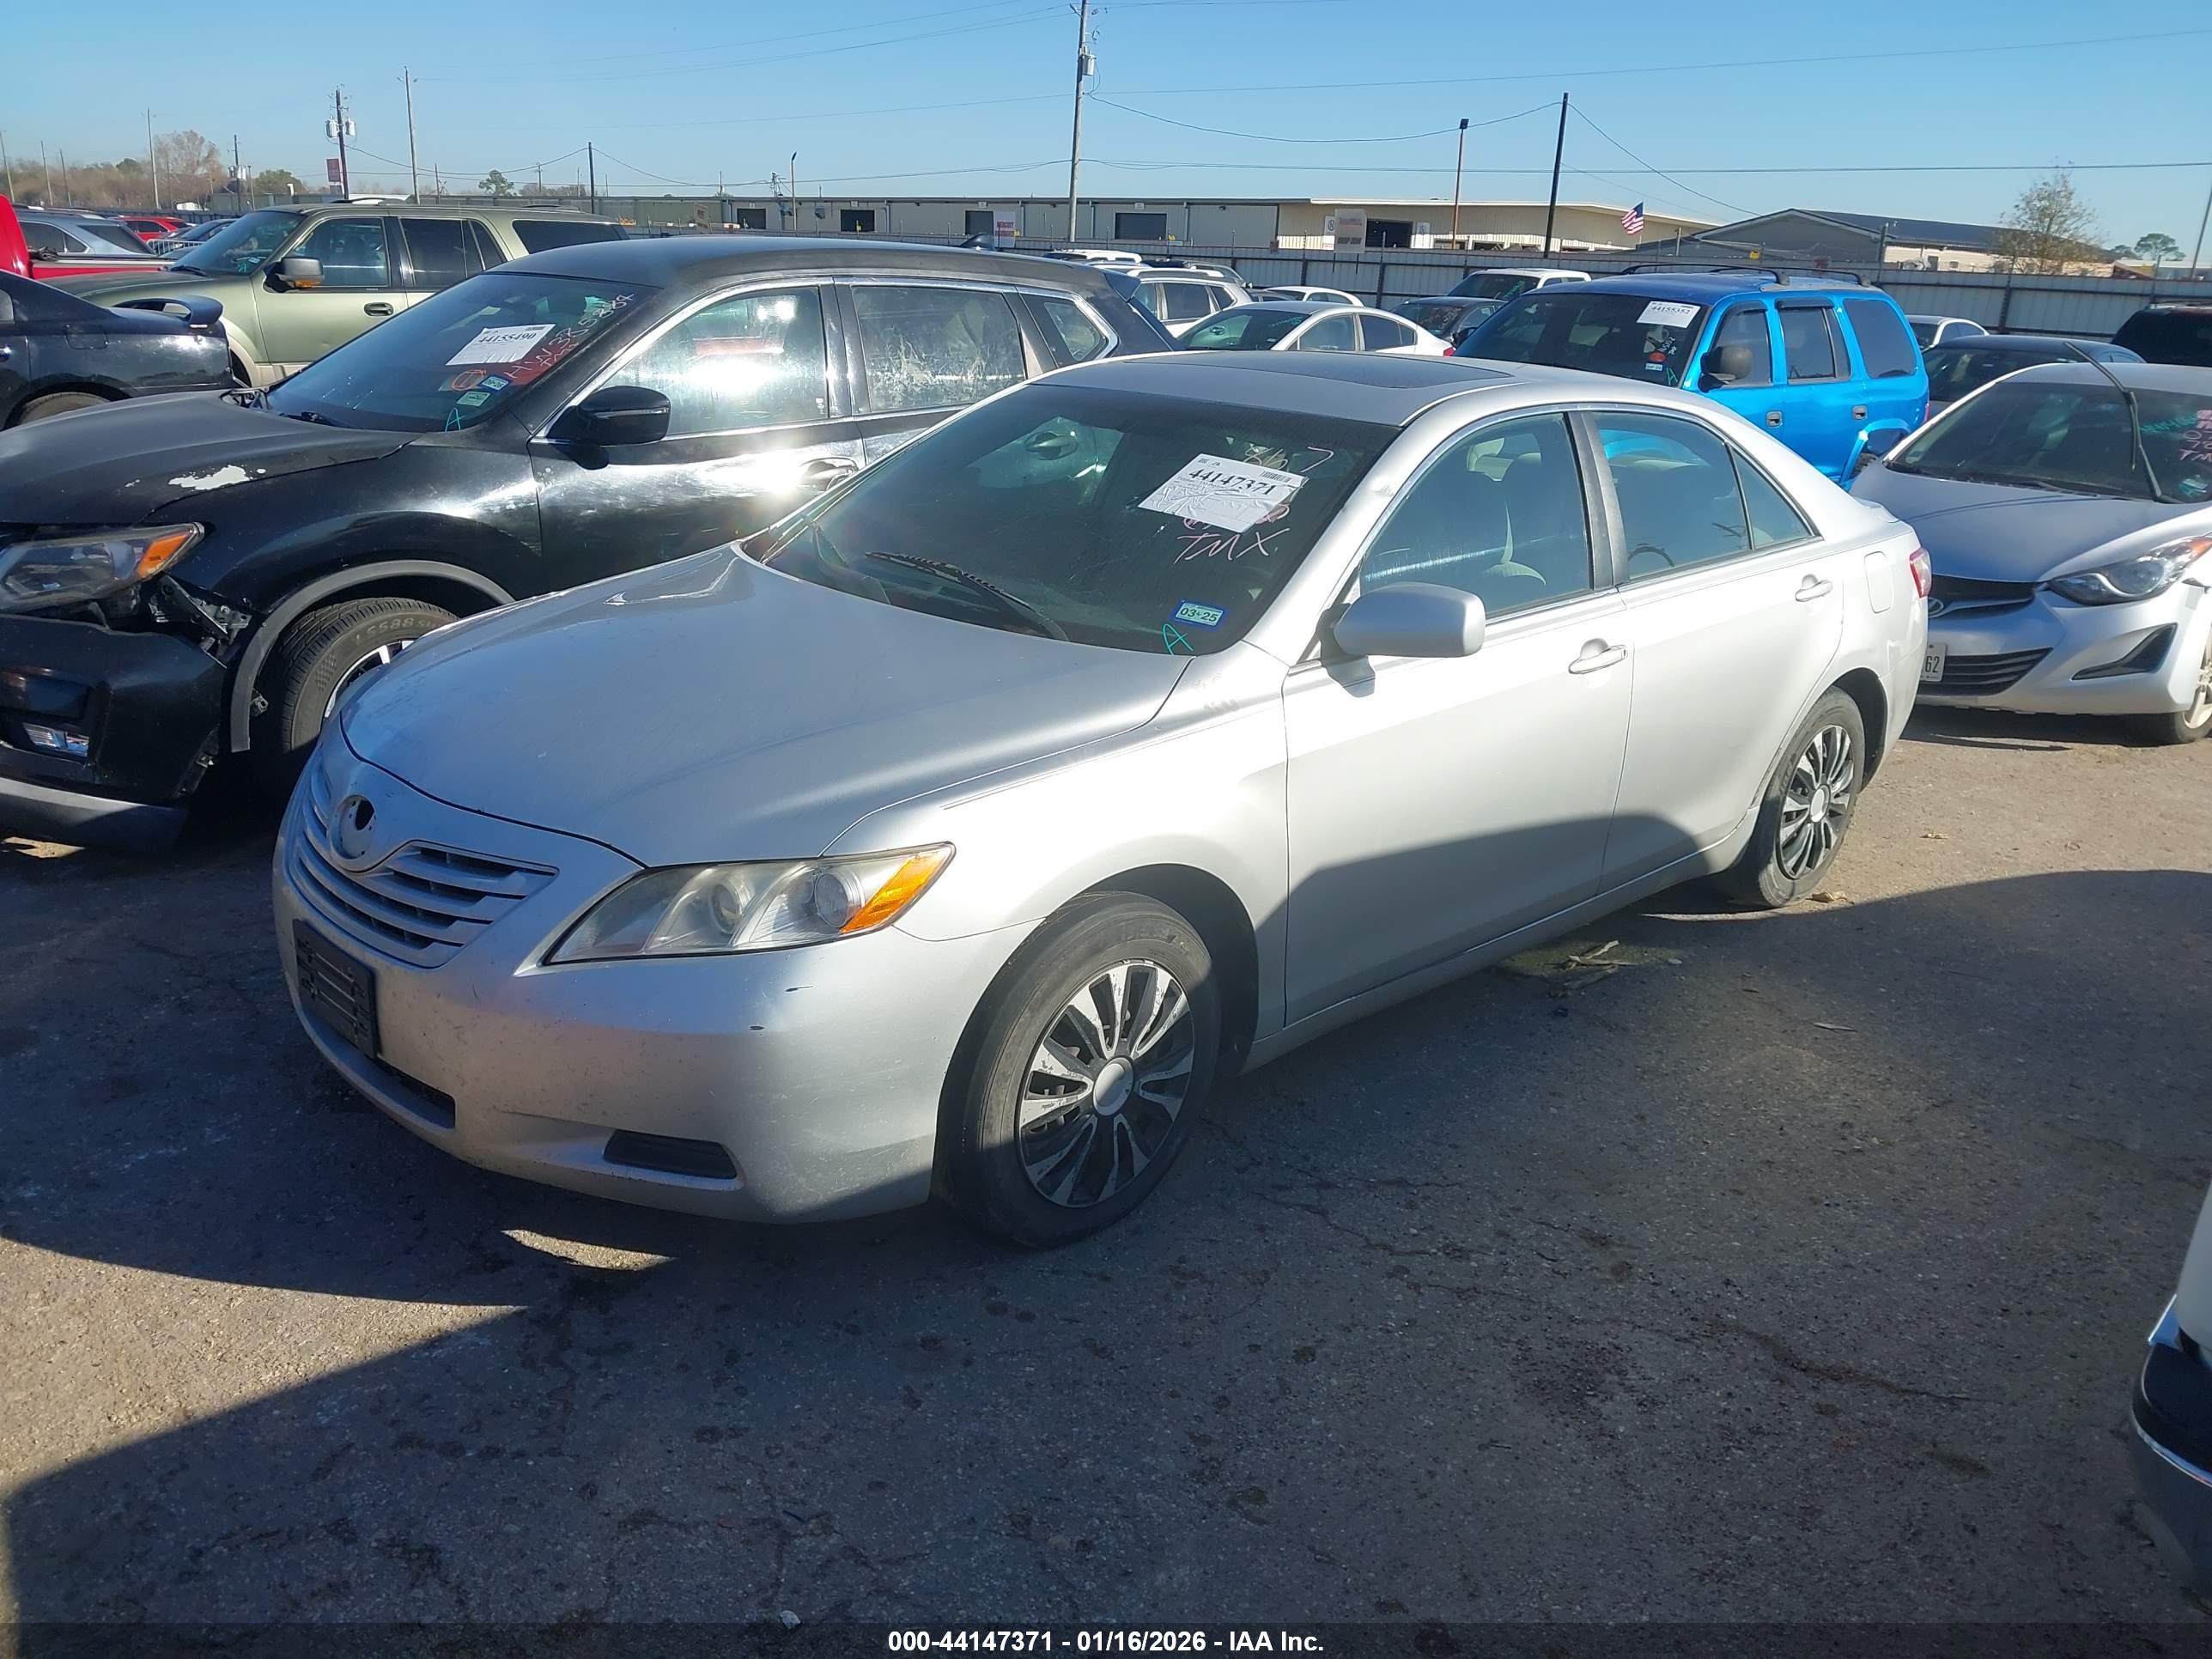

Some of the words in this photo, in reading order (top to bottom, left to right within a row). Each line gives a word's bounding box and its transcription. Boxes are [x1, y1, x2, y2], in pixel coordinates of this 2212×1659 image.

[1188, 468, 1277, 495] 44147371
[1173, 527, 1291, 564] TMX
[1162, 623, 1194, 656] A
